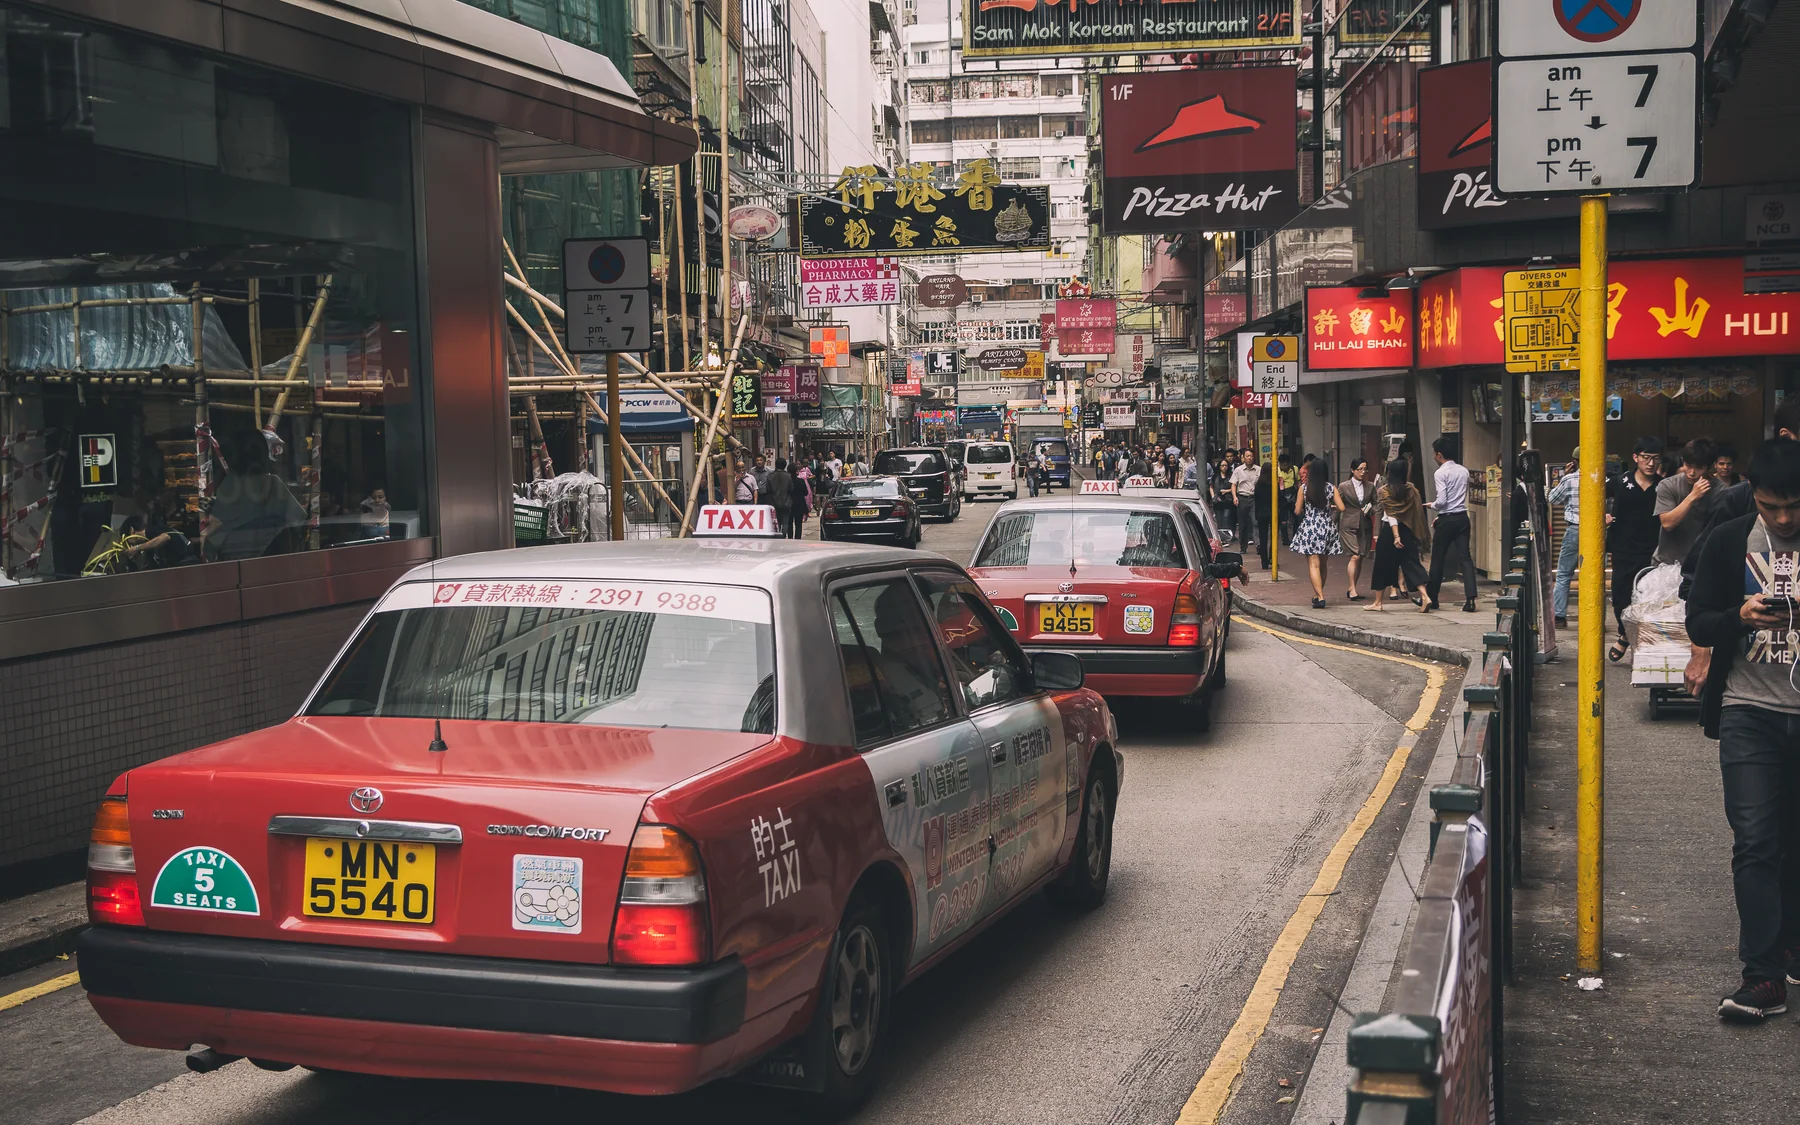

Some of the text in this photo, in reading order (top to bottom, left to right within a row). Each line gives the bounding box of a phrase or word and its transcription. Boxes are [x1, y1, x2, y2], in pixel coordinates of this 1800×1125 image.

[973, 13, 1291, 41] Sam Mok Korean Restaurant 2/F
[1110, 84, 1133, 101] 1/F
[1547, 64, 1659, 108] am 7
[1537, 87, 1593, 112] 上午
[1547, 136, 1658, 179] pm 7
[1536, 158, 1593, 183] 下午
[1442, 171, 1508, 215] Piz
[1122, 183, 1283, 222] Pizza Hut
[1757, 223, 1791, 235] NCB
[803, 258, 869, 270] GOODYEAR
[808, 269, 874, 281] PHARMACY
[806, 281, 897, 305] 合成大藥房
[1528, 280, 1560, 289] 交通改道
[583, 304, 608, 315] 上午
[620, 294, 634, 314] 7
[1312, 307, 1406, 337] 許留山
[1420, 288, 1458, 353] 許留山
[1725, 312, 1788, 337] HUI
[584, 336, 608, 347] 下午
[588, 326, 635, 346] pm 7
[1314, 339, 1402, 350] HUI LAU SHAN
[933, 352, 953, 370] JE
[984, 350, 1021, 358] ARTLAND
[1266, 365, 1285, 374] End
[1261, 376, 1290, 389] 終止
[625, 399, 651, 407] PCCW
[1246, 392, 1262, 404] 24
[1268, 394, 1289, 403] AM
[1166, 413, 1191, 422] THIS
[1084, 482, 1115, 492] TAXI
[1130, 478, 1152, 486] TAXI
[703, 509, 765, 530] TAXI
[585, 588, 645, 608] 2391
[657, 592, 718, 613] 9388
[1055, 603, 1078, 618] KY
[1043, 617, 1092, 632] 9455
[1767, 650, 1794, 664] ME
[152, 809, 184, 819] CROWN
[486, 824, 611, 842] CROWN COMFORT
[751, 807, 795, 861] 的士
[978, 828, 1015, 859] FINNCIAL
[183, 851, 227, 869] TAXI
[341, 842, 399, 880] MN
[194, 868, 215, 892] 5
[758, 848, 801, 908] TAXI
[173, 892, 237, 909] SEATS
[310, 877, 429, 920] 5540
